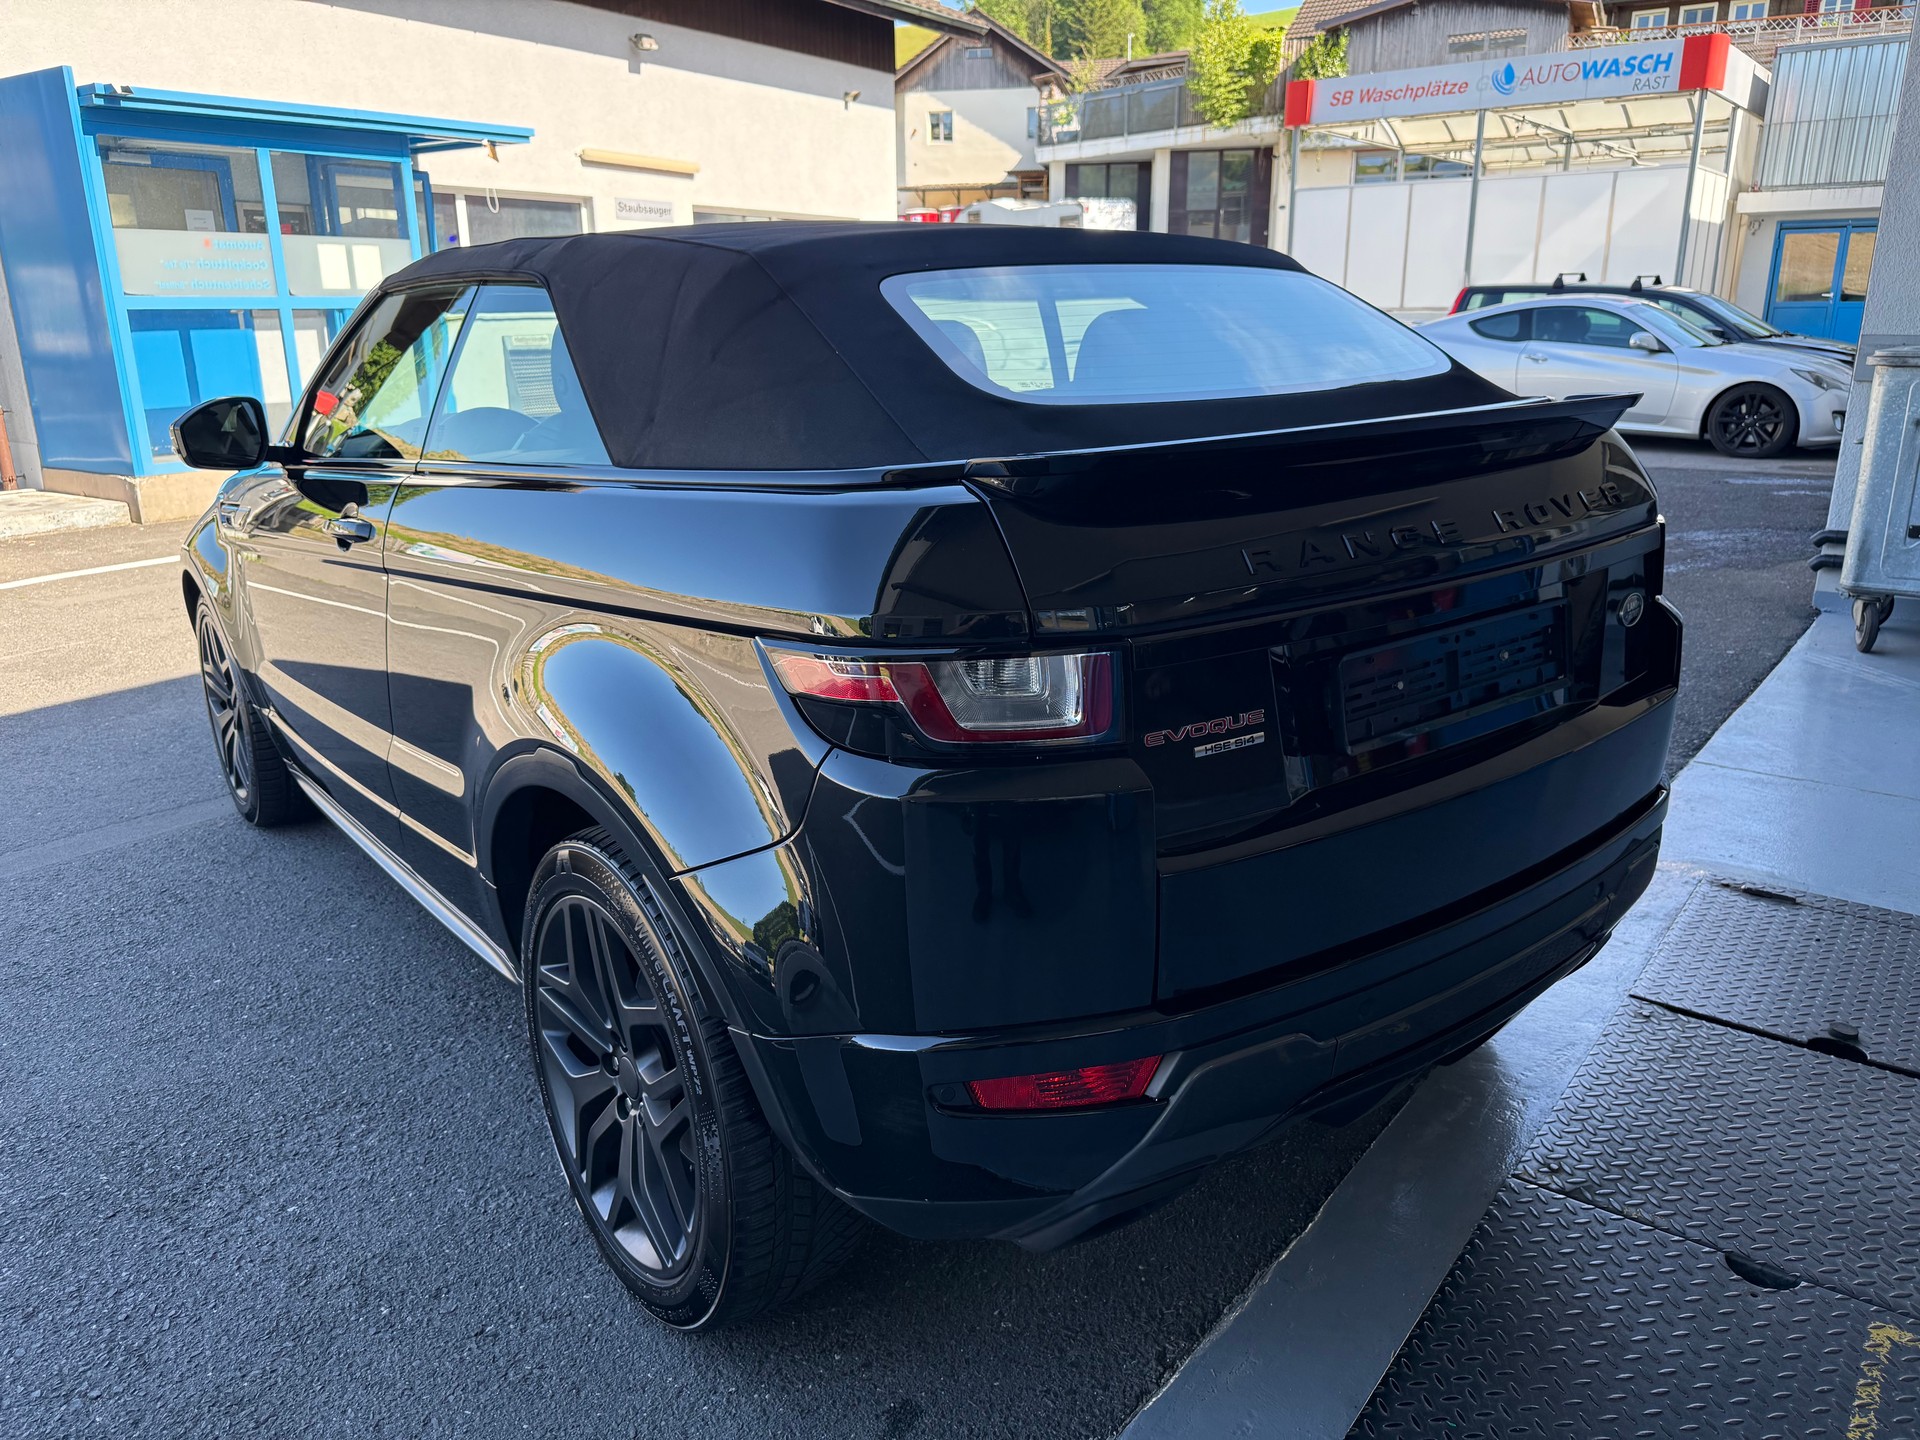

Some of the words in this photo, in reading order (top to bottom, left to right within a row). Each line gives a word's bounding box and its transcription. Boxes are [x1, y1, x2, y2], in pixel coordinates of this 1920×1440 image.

[1519, 52, 1674, 86] AUTOWASCH
[1329, 90, 1354, 107] SB
[1359, 80, 1469, 104] Waschplätze
[1632, 75, 1670, 92] RAST
[617, 201, 672, 217] Staubsauger
[1241, 519, 1463, 576] RANGE
[1492, 481, 1625, 533] ROVER
[1144, 709, 1265, 747] EVOQUE
[1204, 741, 1232, 755] HSE
